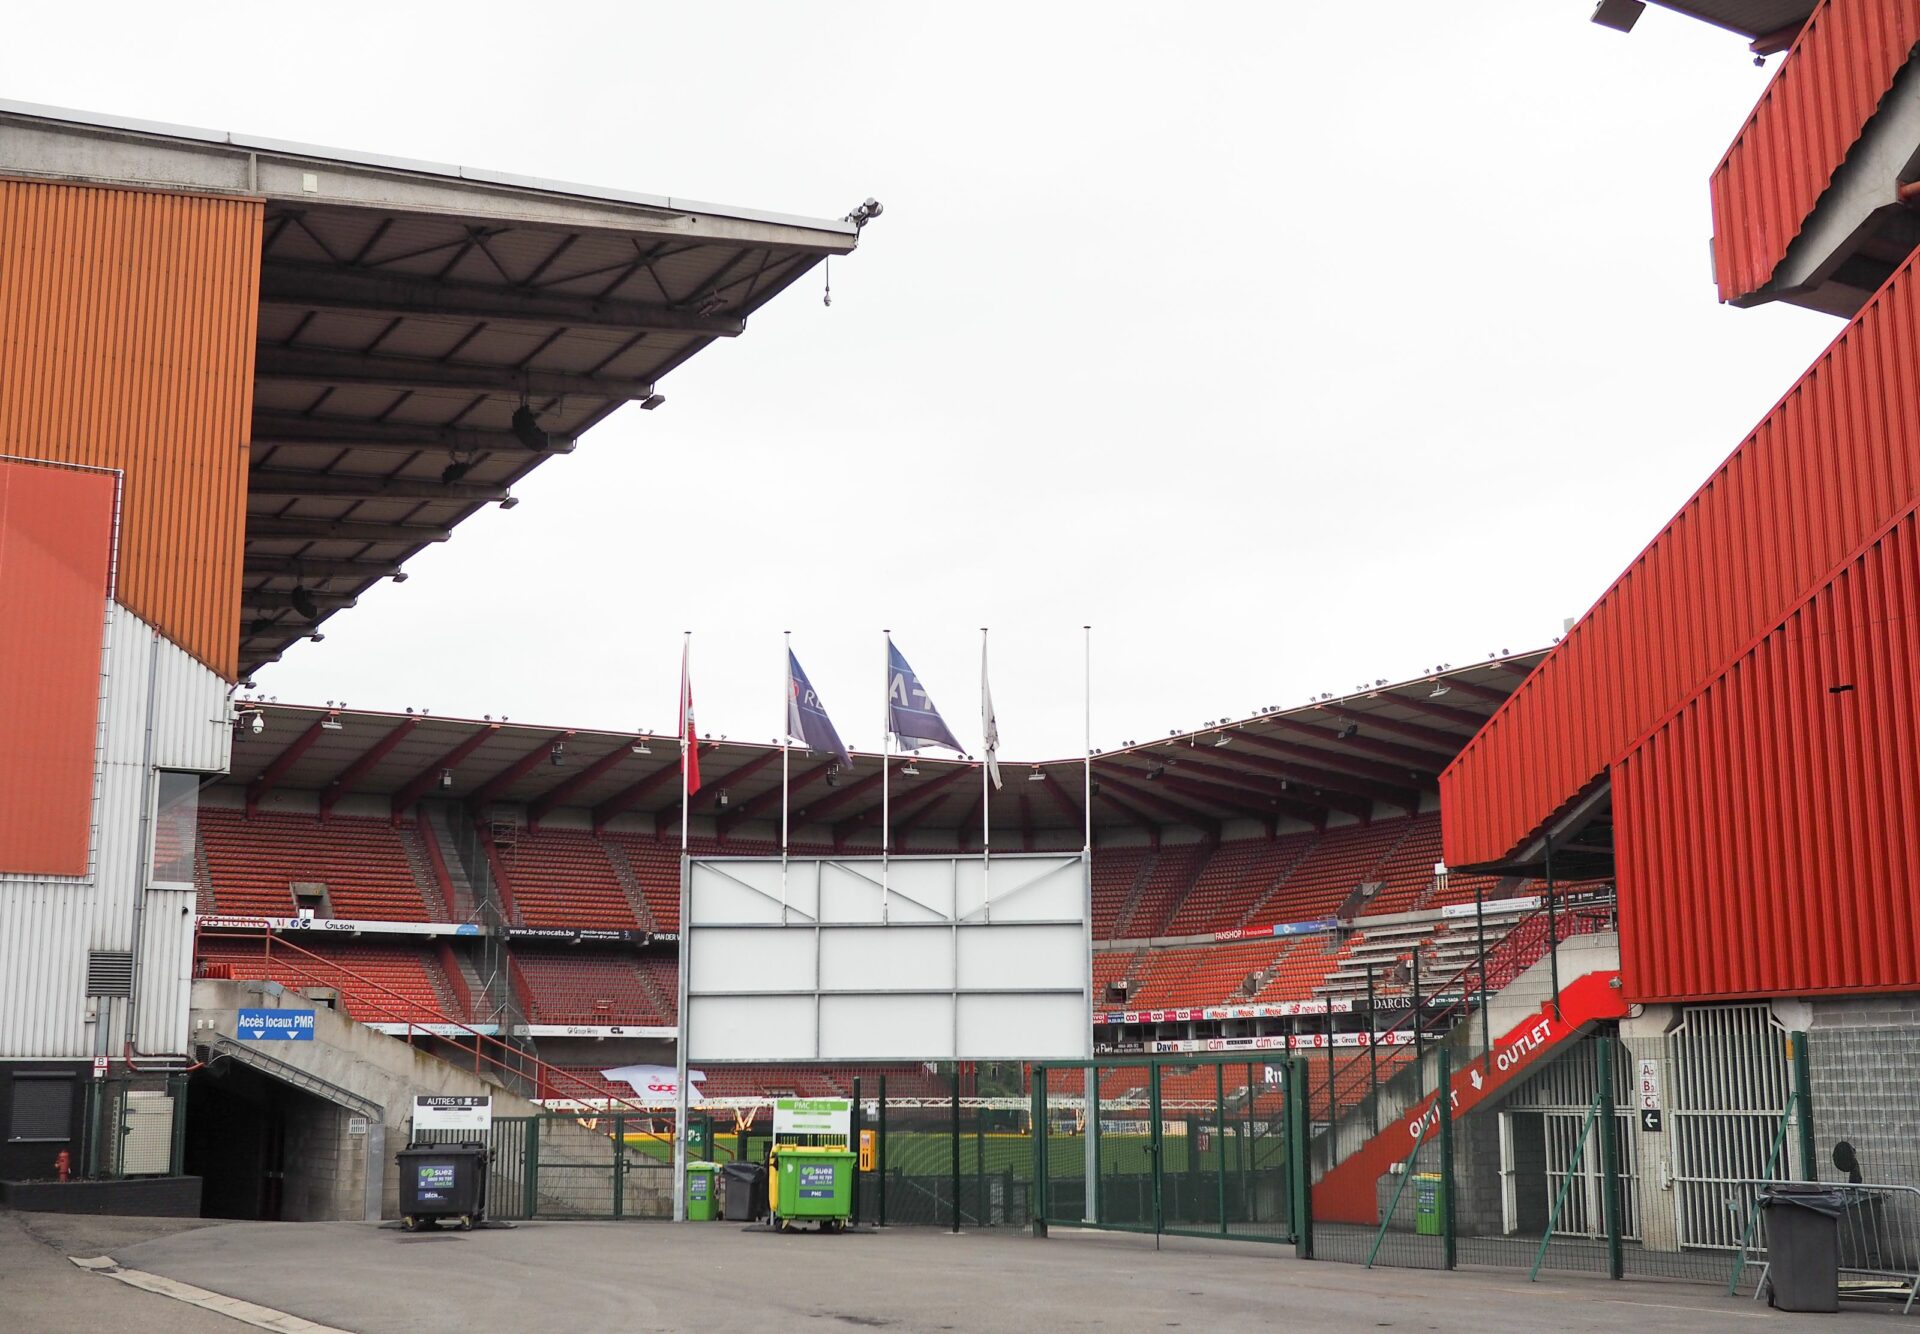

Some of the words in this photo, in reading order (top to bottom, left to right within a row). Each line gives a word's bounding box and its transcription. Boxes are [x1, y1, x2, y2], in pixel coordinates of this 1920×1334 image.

[509, 928, 575, 937] www.br-avocats.be
[1215, 929, 1242, 941] FANSHOP
[1373, 997, 1411, 1009] DARCIS
[239, 1014, 264, 1027] Accès
[265, 1015, 293, 1028] locaux
[294, 1015, 314, 1028] PMR
[1156, 1041, 1179, 1052] Davin
[1497, 1018, 1552, 1071] OUTLET
[1264, 1066, 1282, 1083] R11
[688, 1129, 701, 1141] P3
